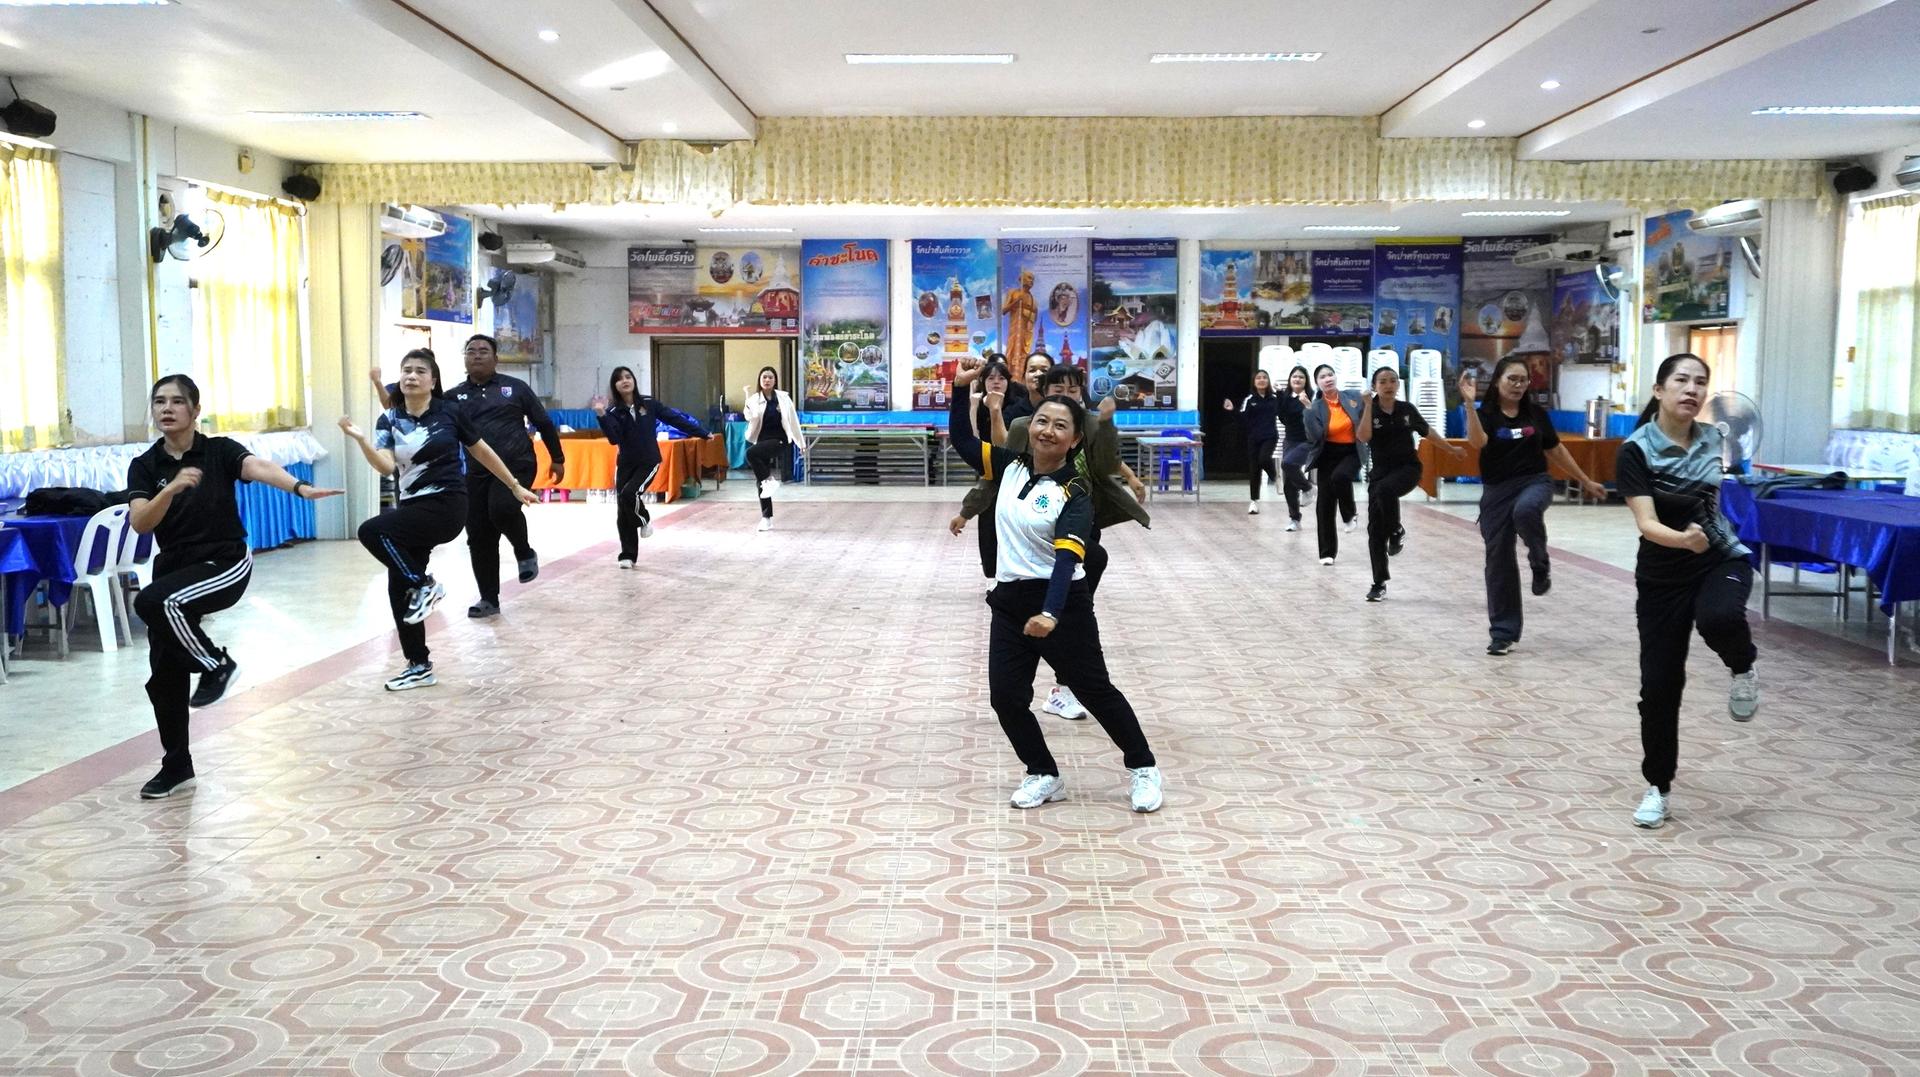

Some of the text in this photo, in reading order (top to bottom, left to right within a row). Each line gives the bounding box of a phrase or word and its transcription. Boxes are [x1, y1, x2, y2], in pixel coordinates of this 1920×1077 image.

[808, 241, 880, 266] คำชะโนด
[1004, 240, 1067, 254] วัดพระแท่น
[630, 249, 695, 265] วัดโพธิ์ศรีทุ่ง
